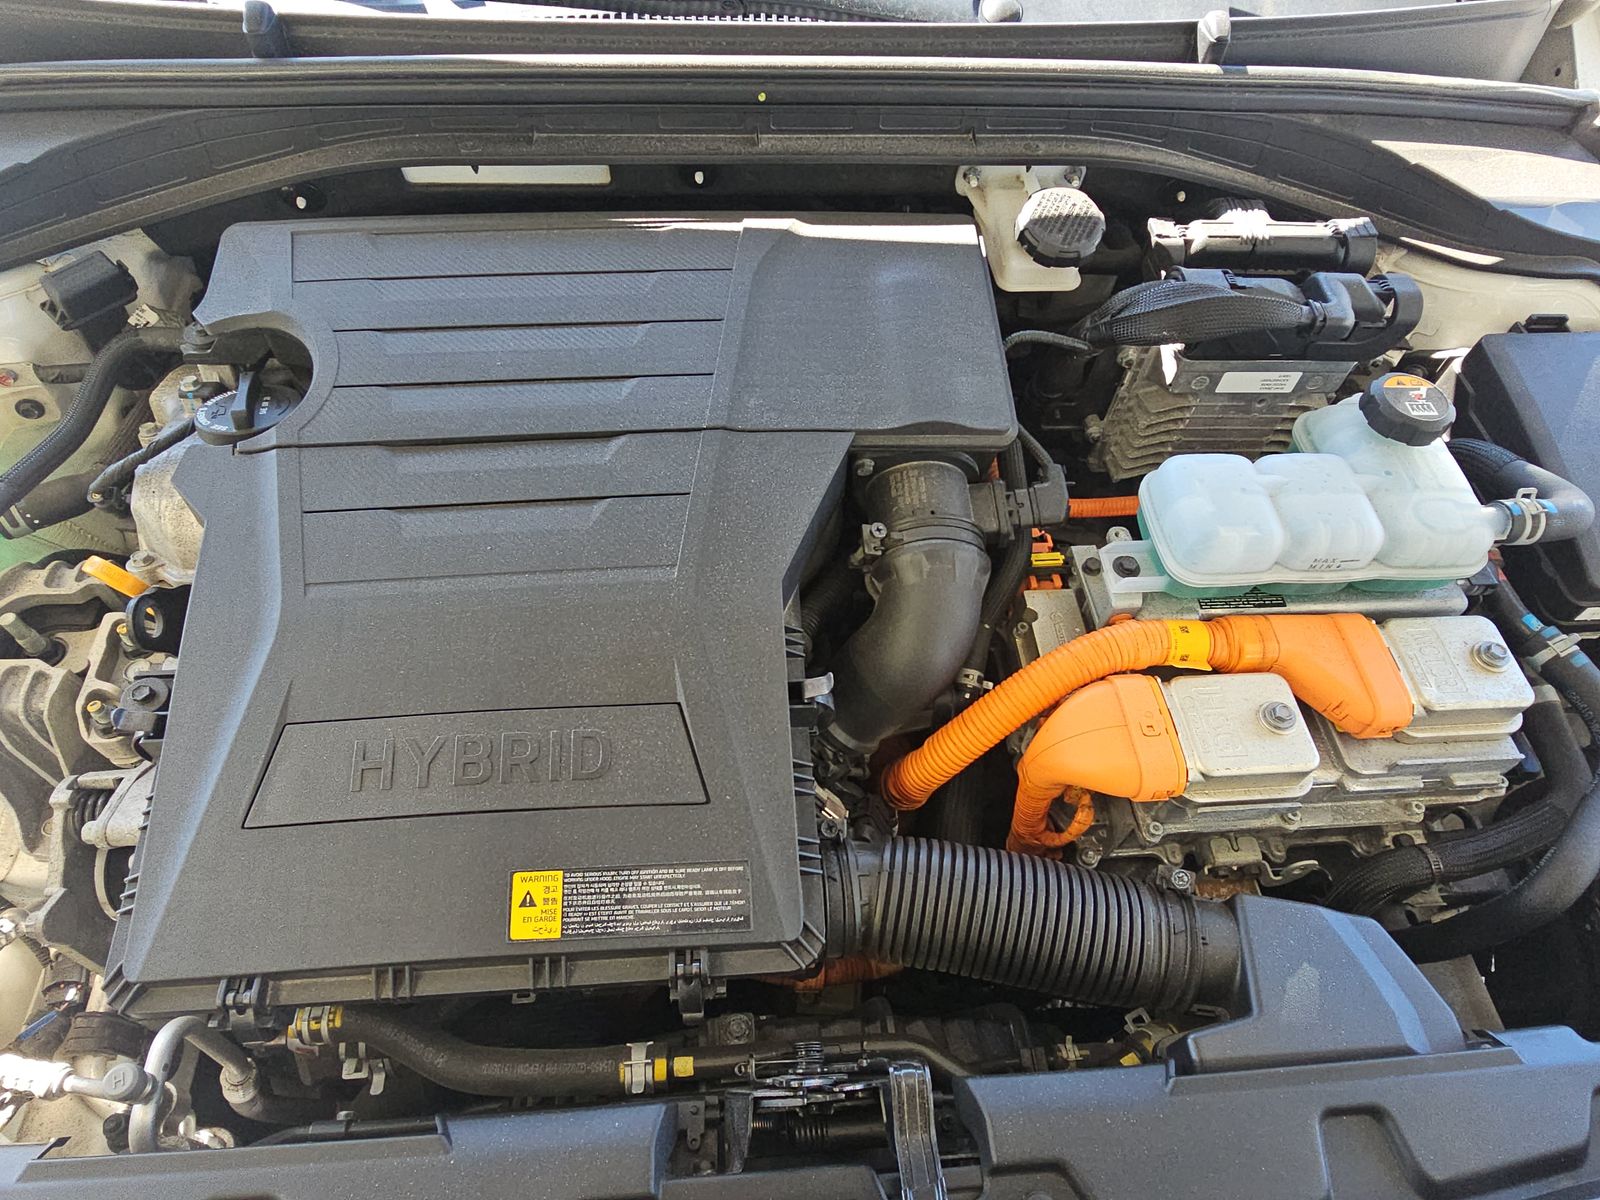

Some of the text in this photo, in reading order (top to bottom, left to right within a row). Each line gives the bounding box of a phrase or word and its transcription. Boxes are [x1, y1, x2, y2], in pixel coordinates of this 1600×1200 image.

[350, 728, 612, 792] HYBRID
[520, 874, 559, 883] WARNING
[543, 886, 558, 894] 경고
